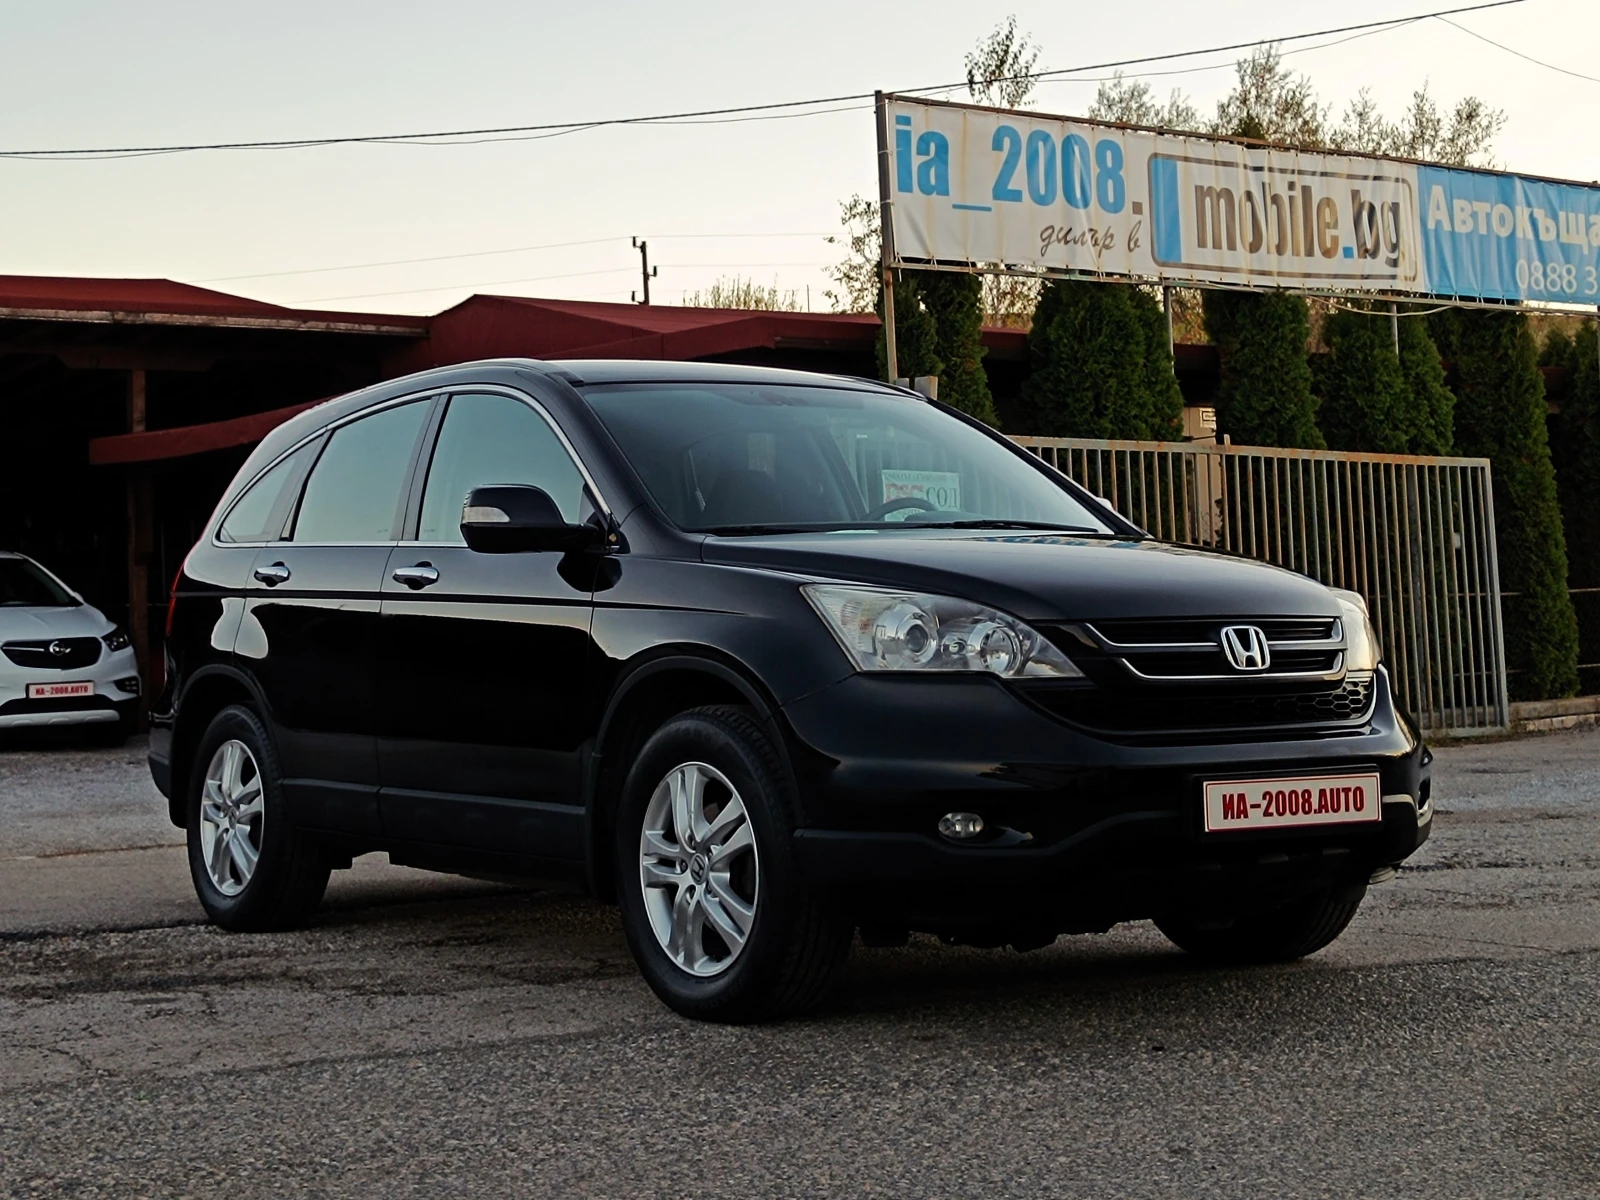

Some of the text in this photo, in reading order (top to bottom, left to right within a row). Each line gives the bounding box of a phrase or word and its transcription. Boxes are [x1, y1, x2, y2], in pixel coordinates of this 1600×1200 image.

[1041, 224, 1115, 257] дилър
[1194, 182, 1400, 268] mobile.bg
[1428, 187, 1600, 255] Автокъща
[1515, 260, 1598, 295] 0888 3
